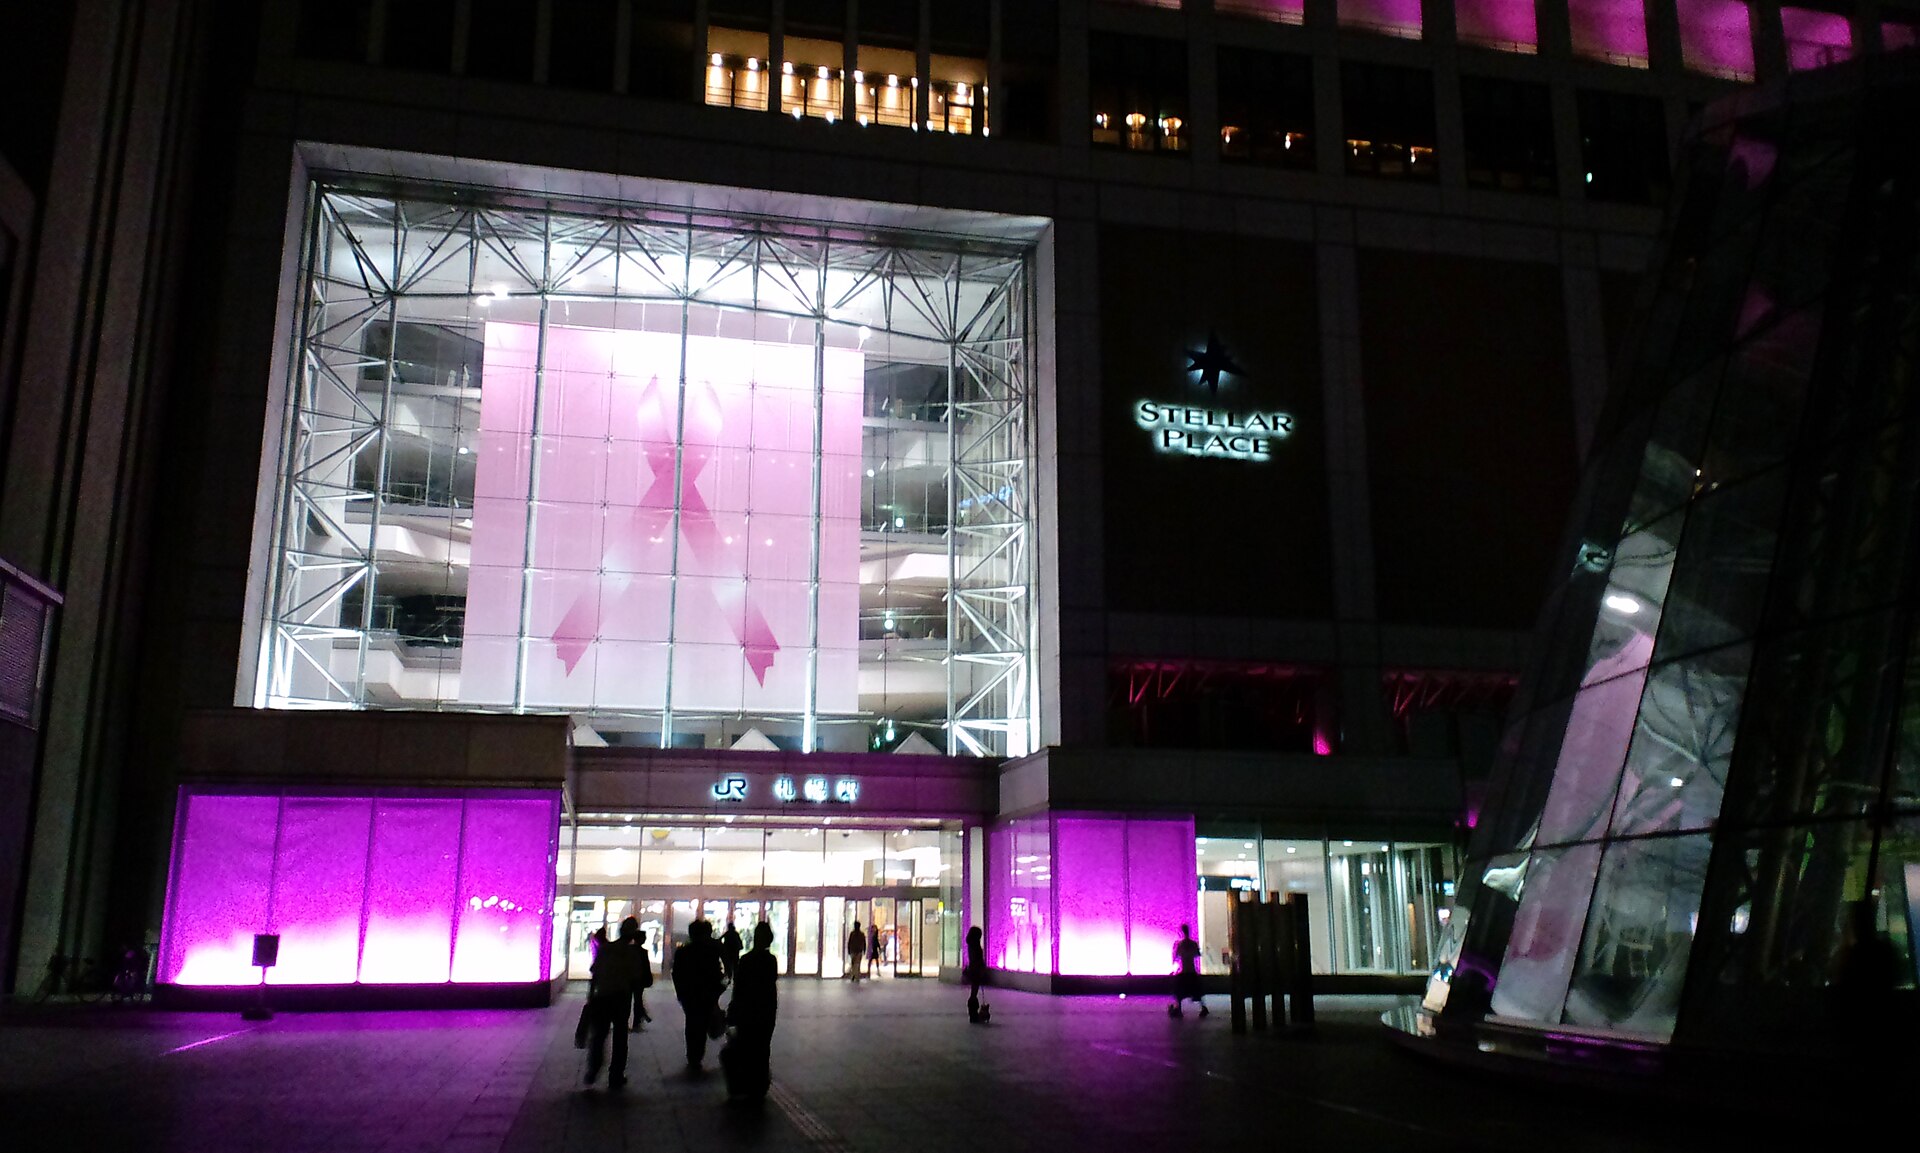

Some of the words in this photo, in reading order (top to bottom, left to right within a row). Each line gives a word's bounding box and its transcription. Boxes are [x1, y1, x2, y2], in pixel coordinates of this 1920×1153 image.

[1139, 402, 1293, 432] STELLAR
[1163, 429, 1271, 454] PLACE
[714, 778, 747, 796] JR
